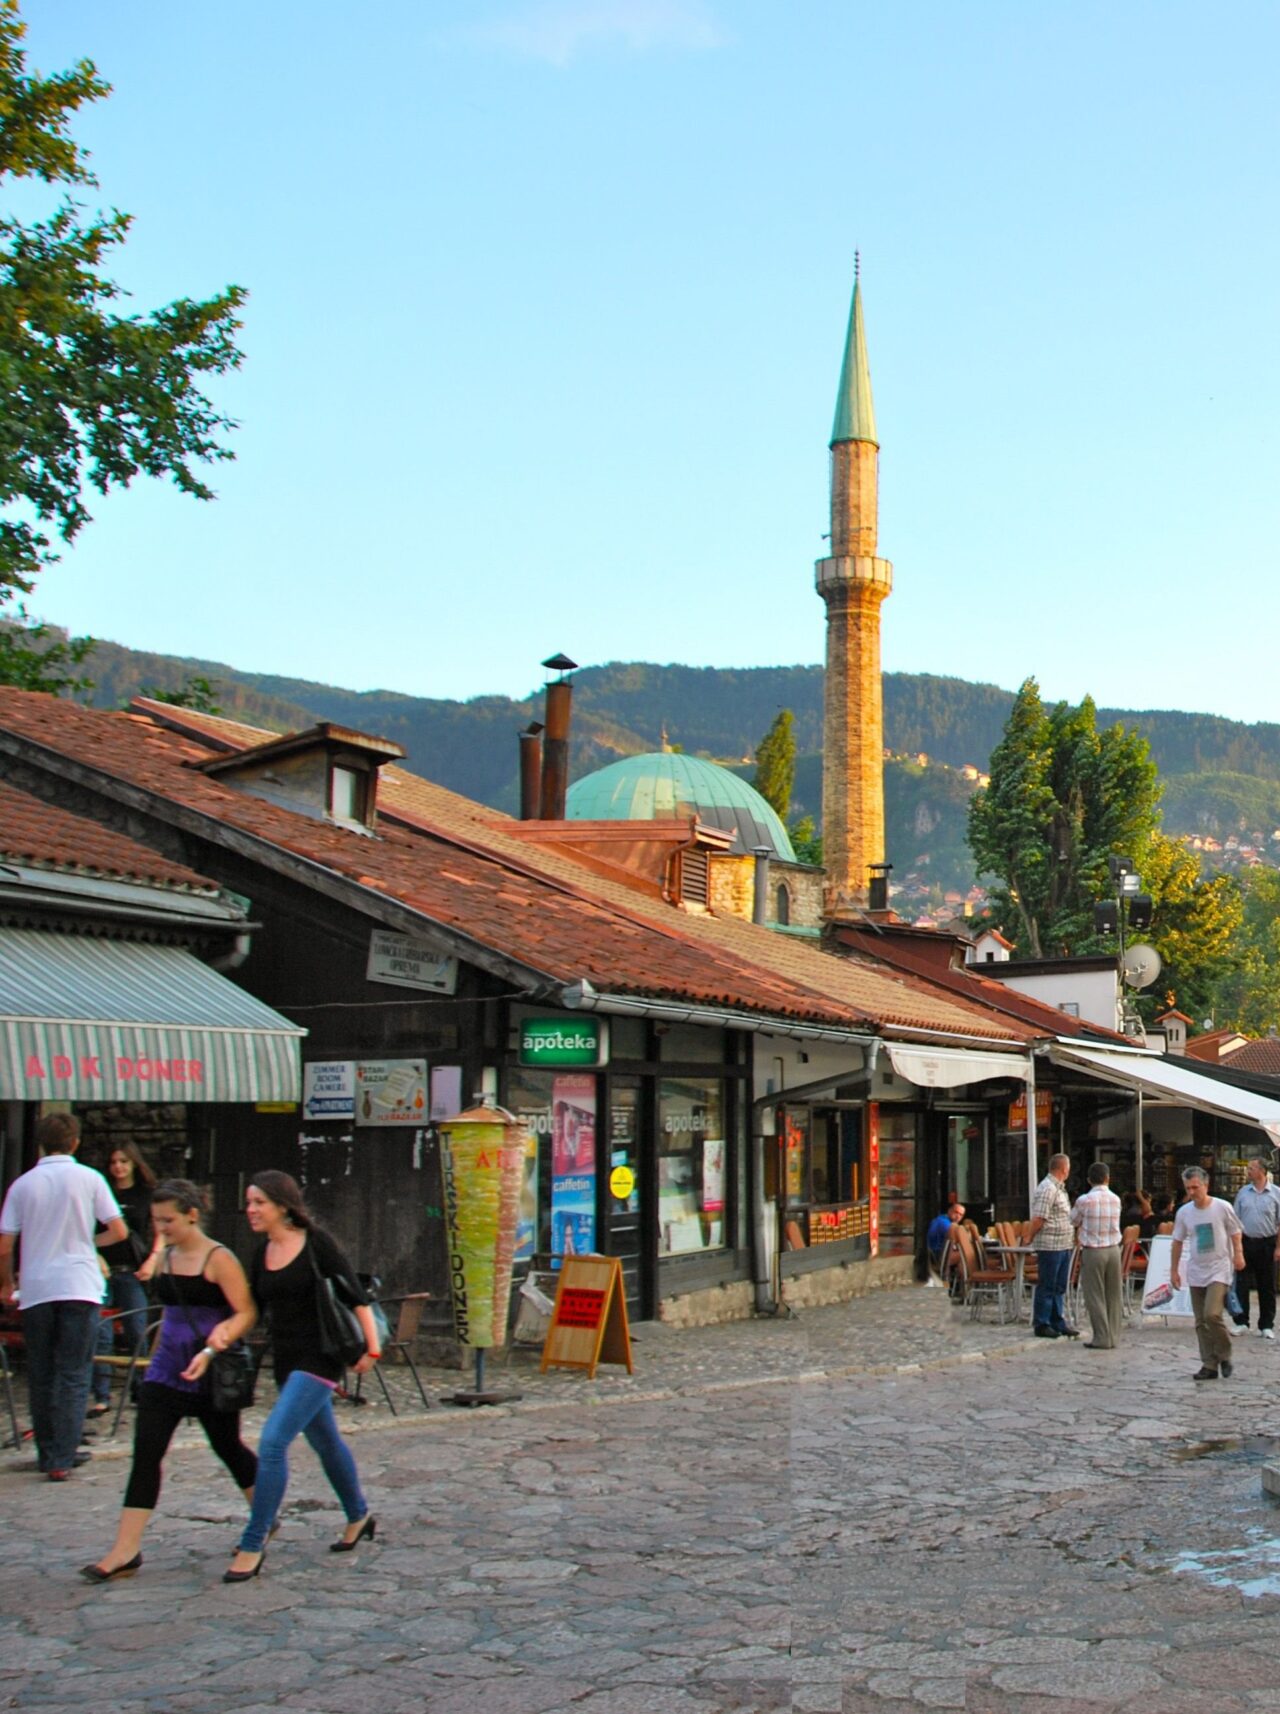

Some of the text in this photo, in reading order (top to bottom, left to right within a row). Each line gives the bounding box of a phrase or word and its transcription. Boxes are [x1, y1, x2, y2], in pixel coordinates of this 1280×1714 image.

[523, 1032, 597, 1053] apoteka
[665, 1110, 714, 1137] apoteka
[553, 1178, 591, 1192] caffetin
[451, 1254, 470, 1345] DONER
